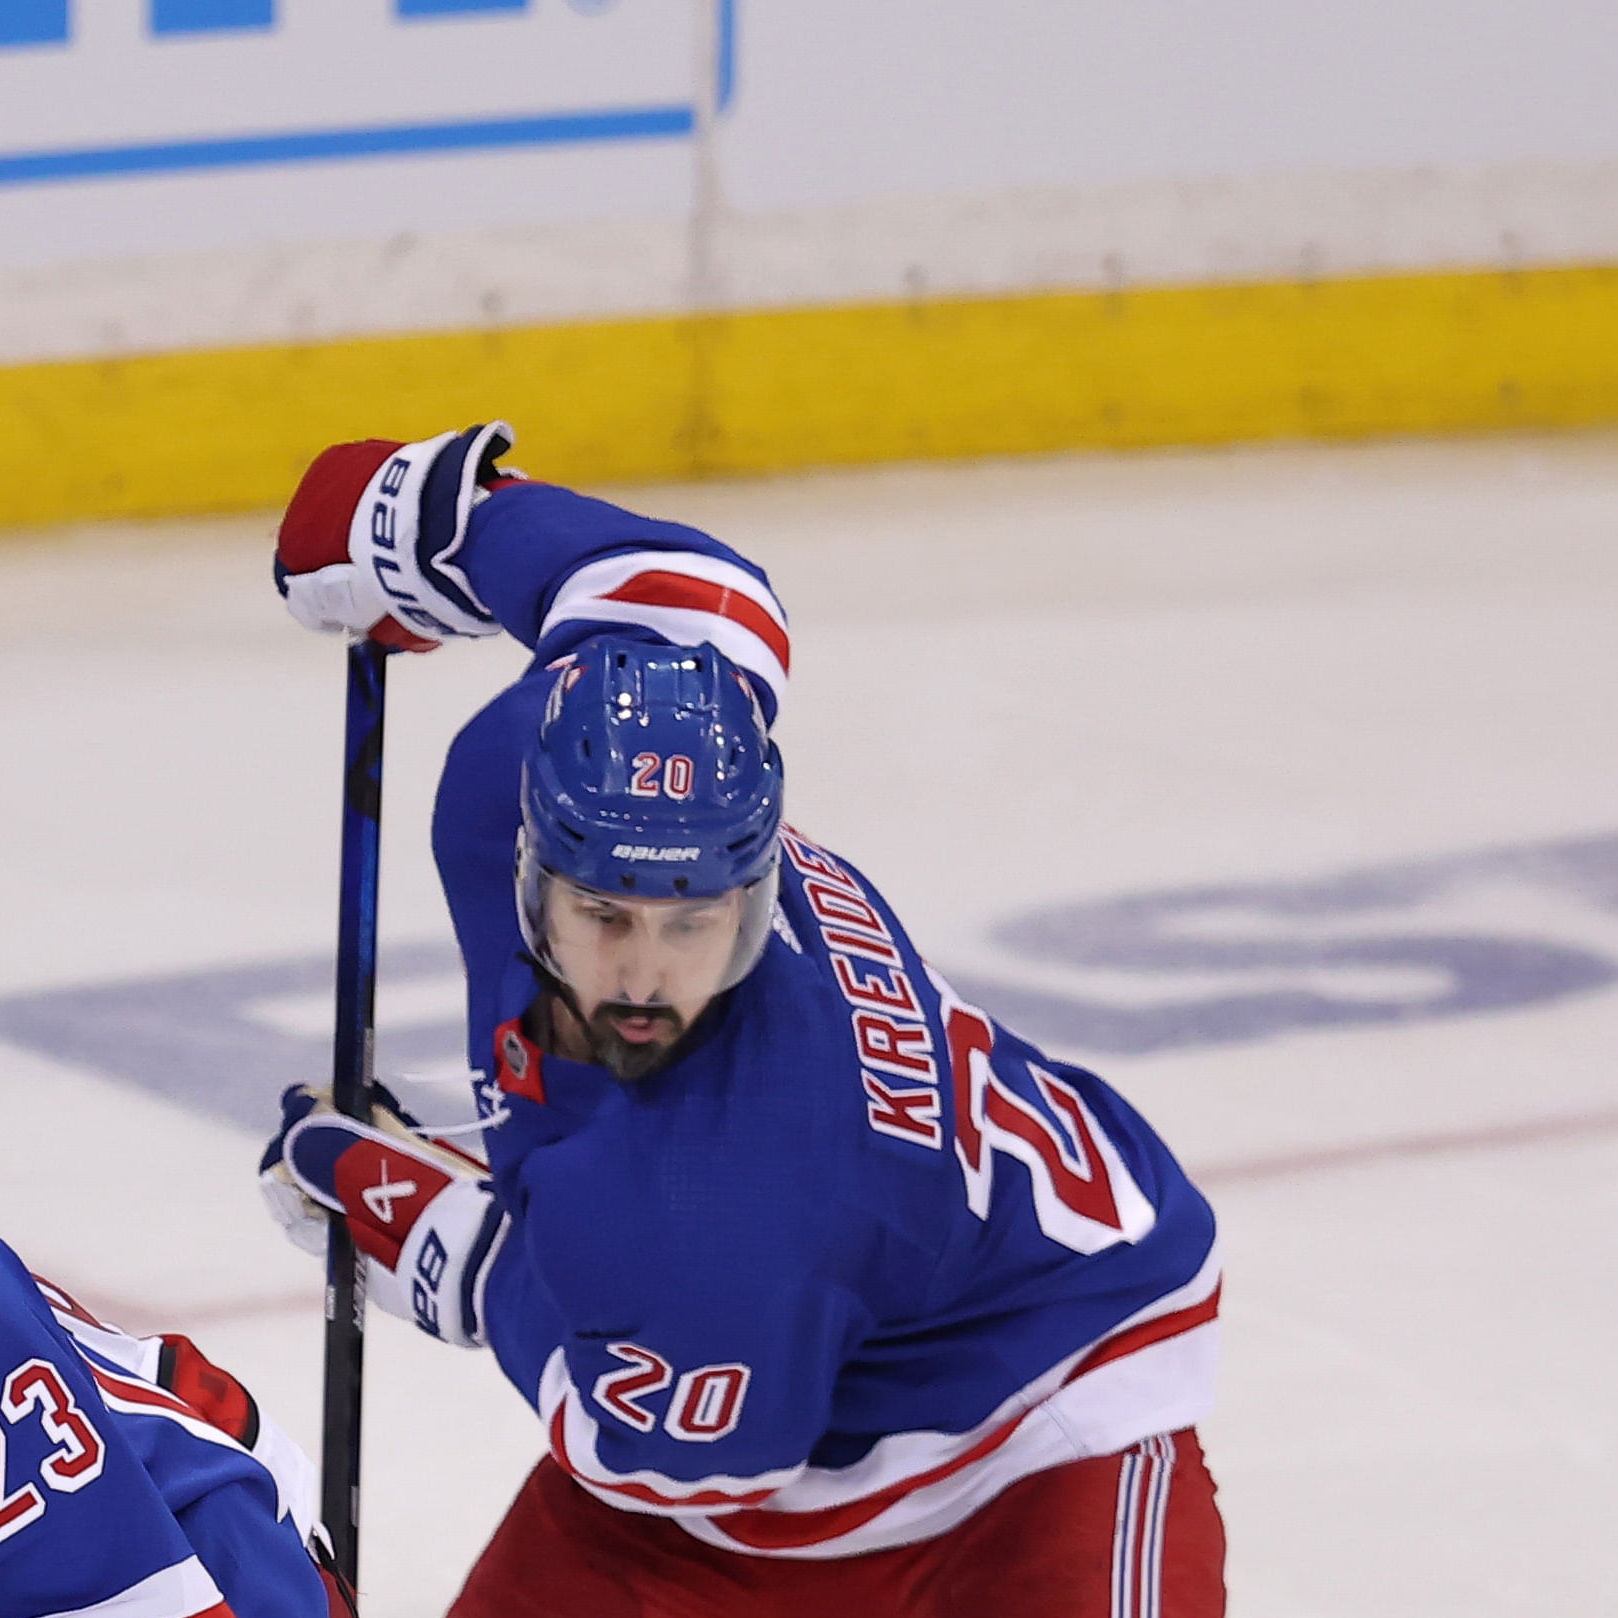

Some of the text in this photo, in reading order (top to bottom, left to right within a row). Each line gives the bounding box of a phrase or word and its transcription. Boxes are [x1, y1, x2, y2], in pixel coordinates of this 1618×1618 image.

[630, 752, 694, 800] 20
[611, 844, 701, 862] BAUER
[778, 822, 942, 1151] KREIDE
[591, 1341, 752, 1442] 20
